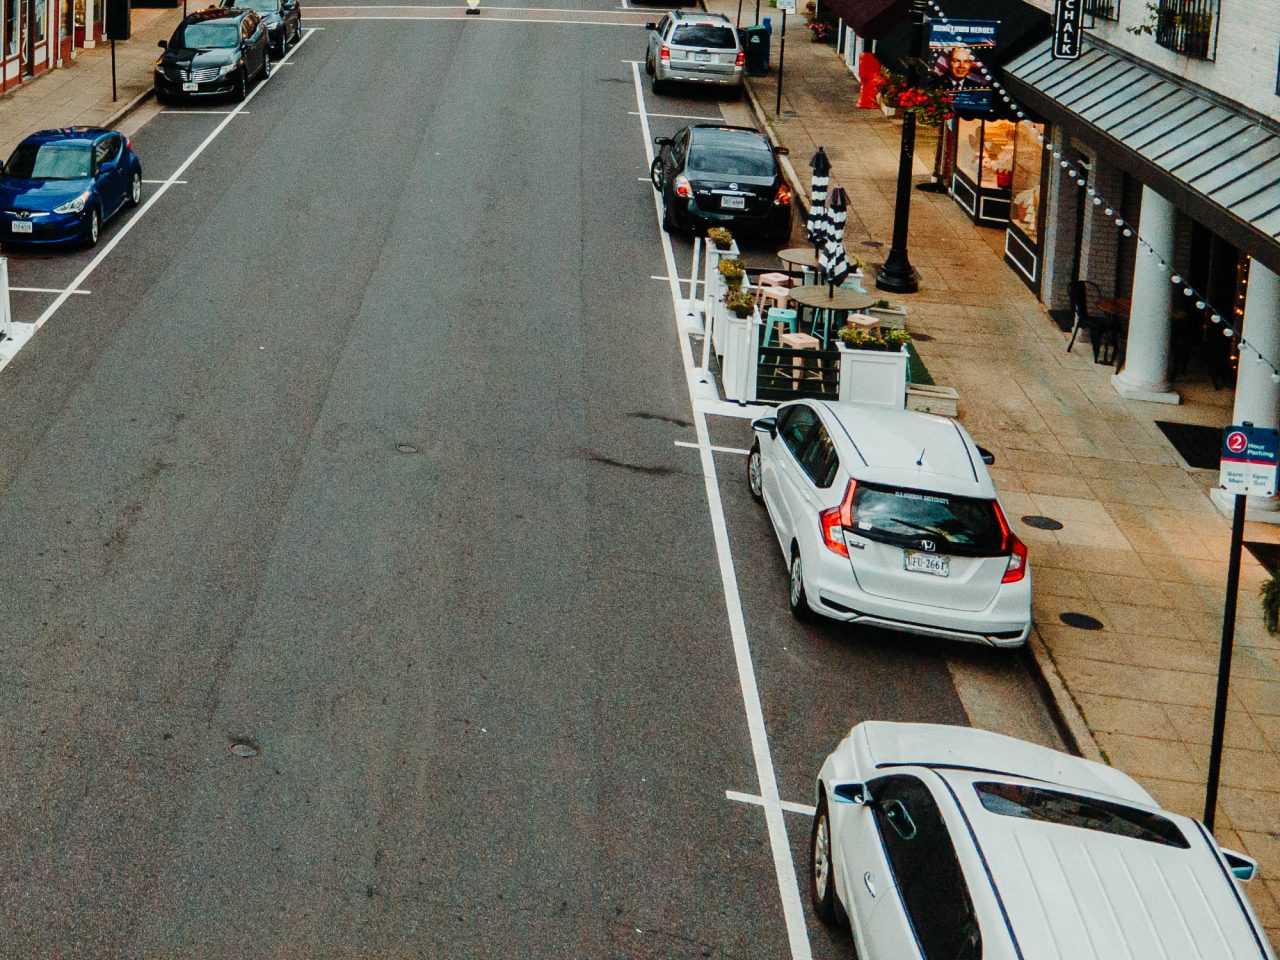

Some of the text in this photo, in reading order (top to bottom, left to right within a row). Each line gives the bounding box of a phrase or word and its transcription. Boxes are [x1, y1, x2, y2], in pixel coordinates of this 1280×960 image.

[1231, 435, 1242, 449] 2
[1247, 443, 1265, 451] Hour
[1247, 449, 1274, 458] Parking
